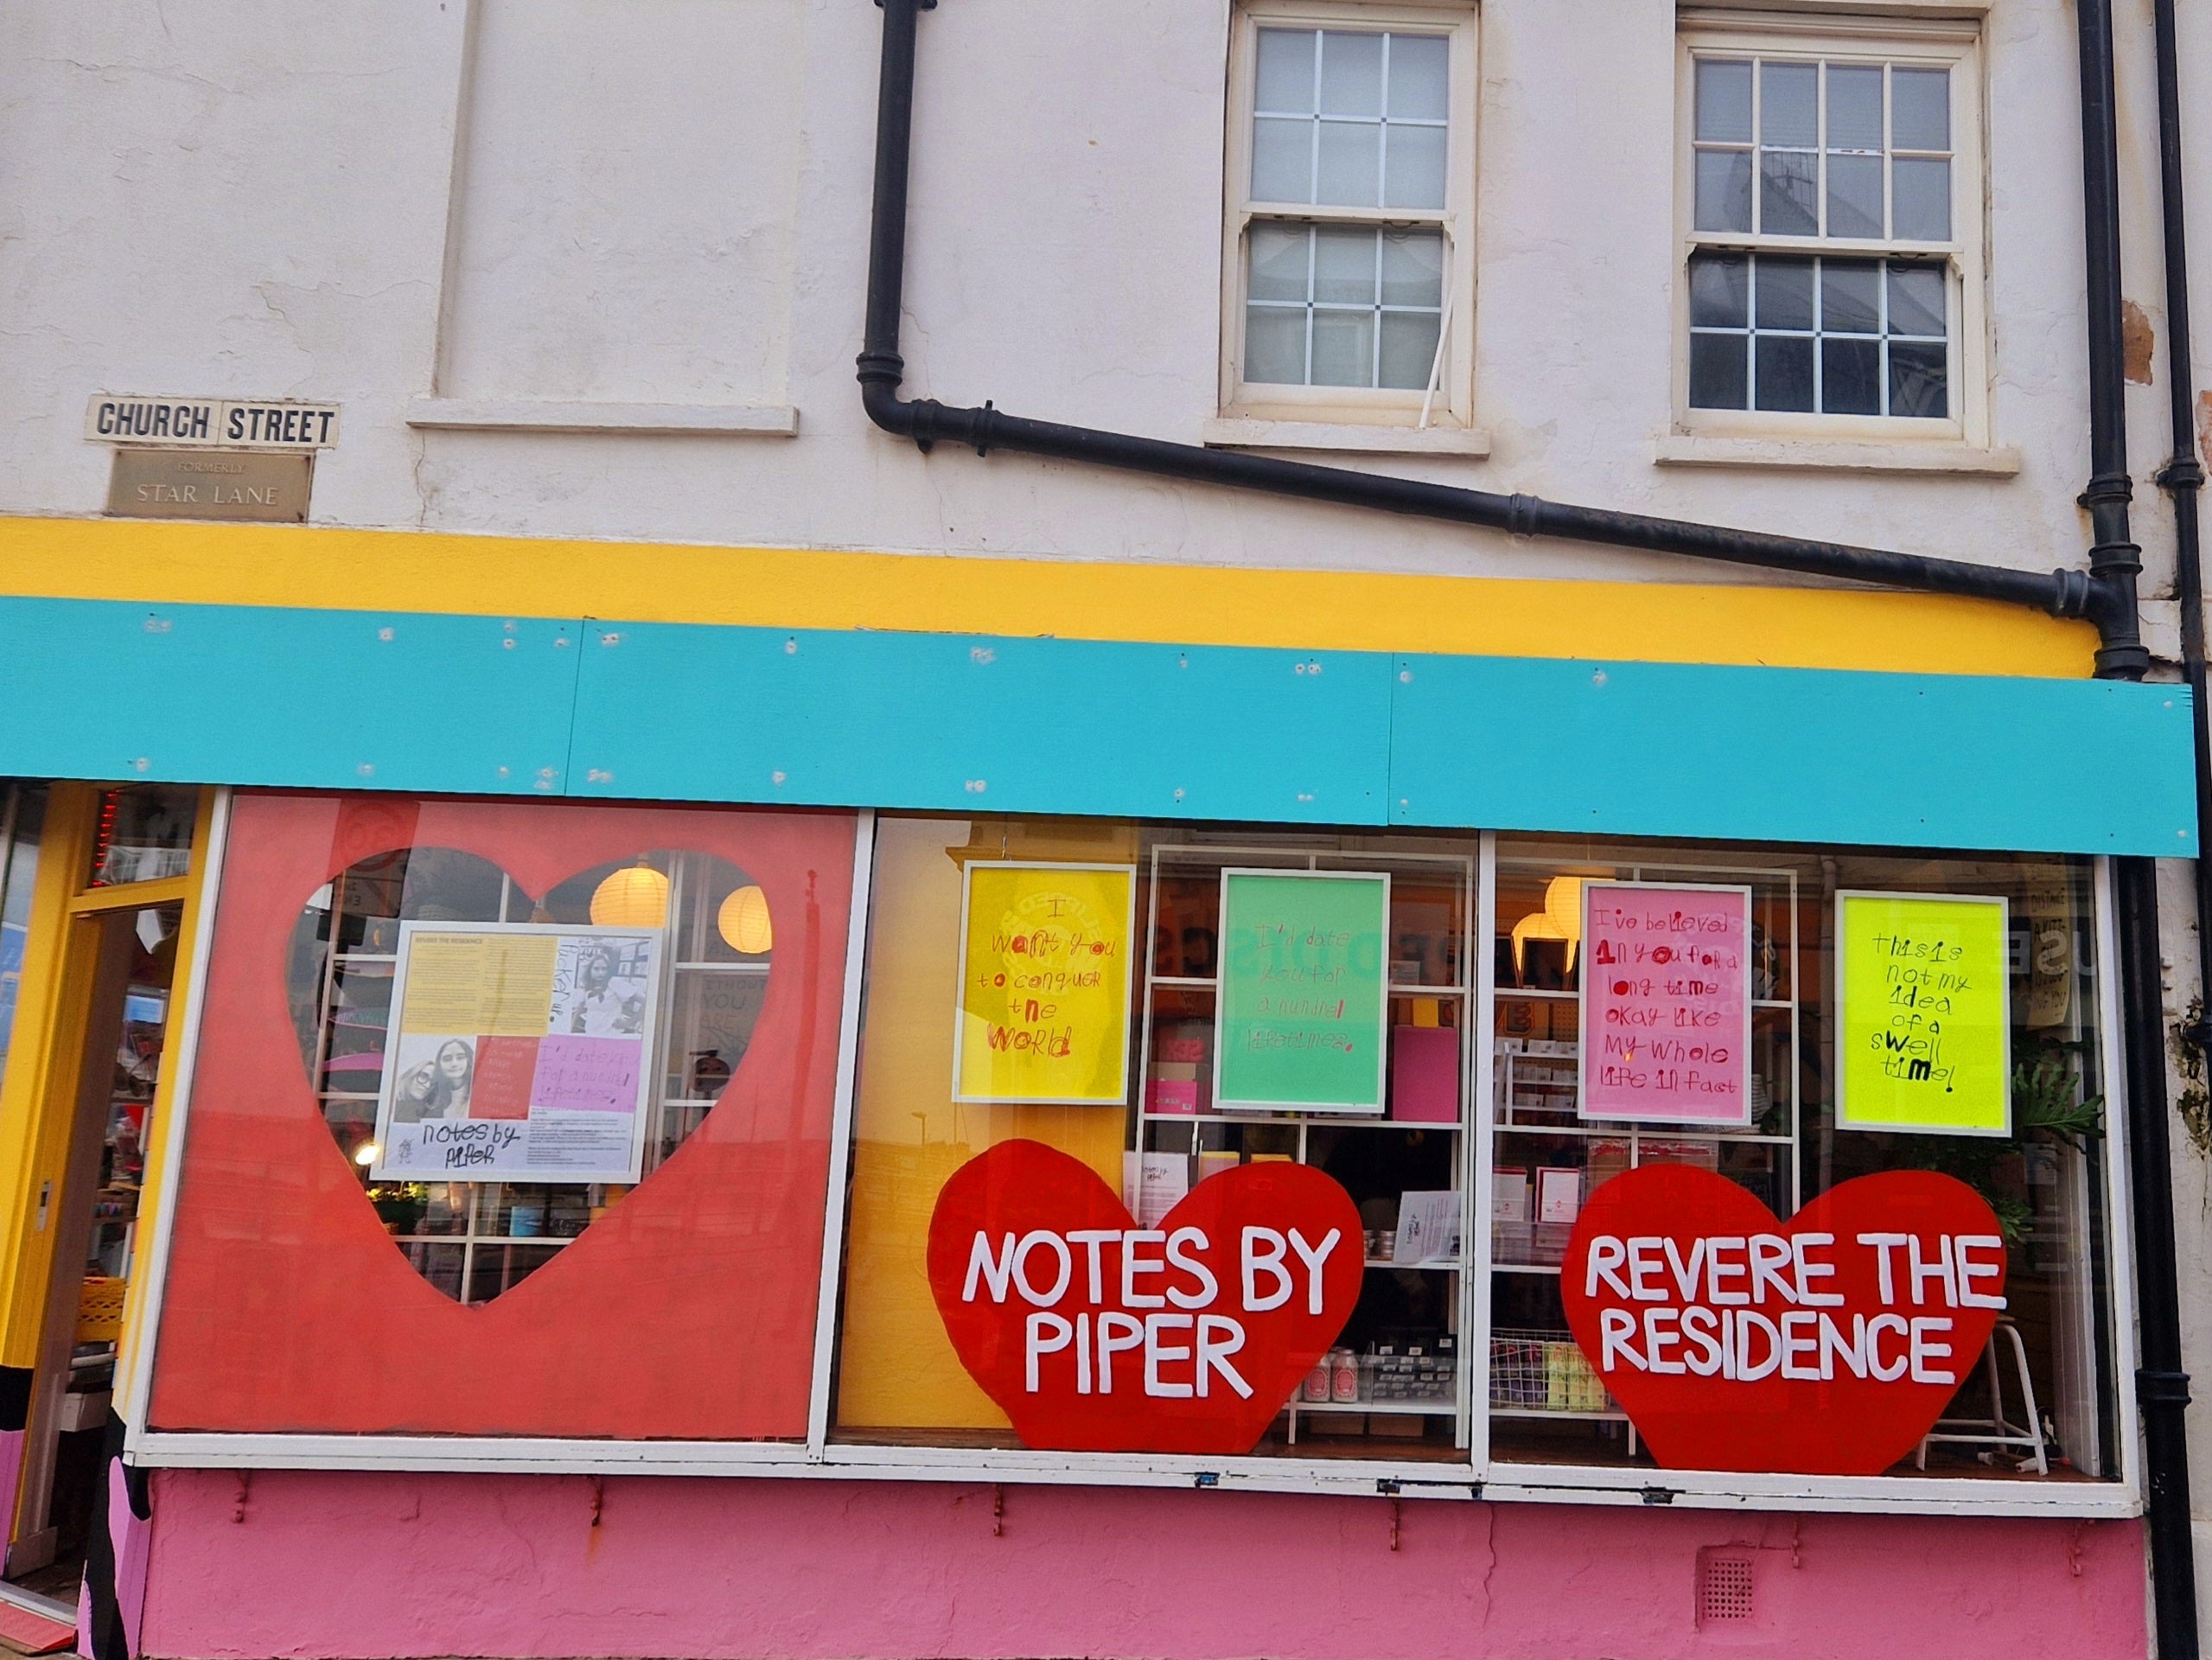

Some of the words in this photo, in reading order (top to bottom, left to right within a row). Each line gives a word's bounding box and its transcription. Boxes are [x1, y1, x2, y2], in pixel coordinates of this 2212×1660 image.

[97, 403, 210, 438] CHURCH
[227, 407, 335, 443] STREET
[177, 462, 245, 474] FORMERLY
[137, 484, 198, 503] STAR
[214, 486, 278, 506] LANE
[1047, 899, 1066, 918] I
[1070, 932, 1117, 958] you
[1254, 923, 1296, 949] I'd
[1306, 926, 1350, 948] date
[1634, 942, 1681, 964] you
[1726, 954, 1737, 969] a
[977, 973, 1006, 989] to
[1608, 975, 1655, 997] long
[1664, 979, 1719, 996] time
[1886, 963, 1936, 986] not
[1937, 973, 1973, 993] my
[1256, 996, 1272, 1013] a
[1889, 984, 1953, 1016] idea
[1891, 1013, 1922, 1032] of
[1928, 1019, 1940, 1035] a
[1871, 1030, 1942, 1065] swell
[1683, 1069, 1737, 1094] fast
[424, 1122, 489, 1146] notes
[493, 1123, 521, 1149] by
[961, 1226, 1219, 1310] NOTES
[1241, 1225, 1341, 1315] BY
[1585, 1233, 1845, 1306] REVERE
[1857, 1233, 2008, 1310] THE
[1025, 1312, 1254, 1400] PIPER
[1600, 1306, 1956, 1384] RESIDENCE
